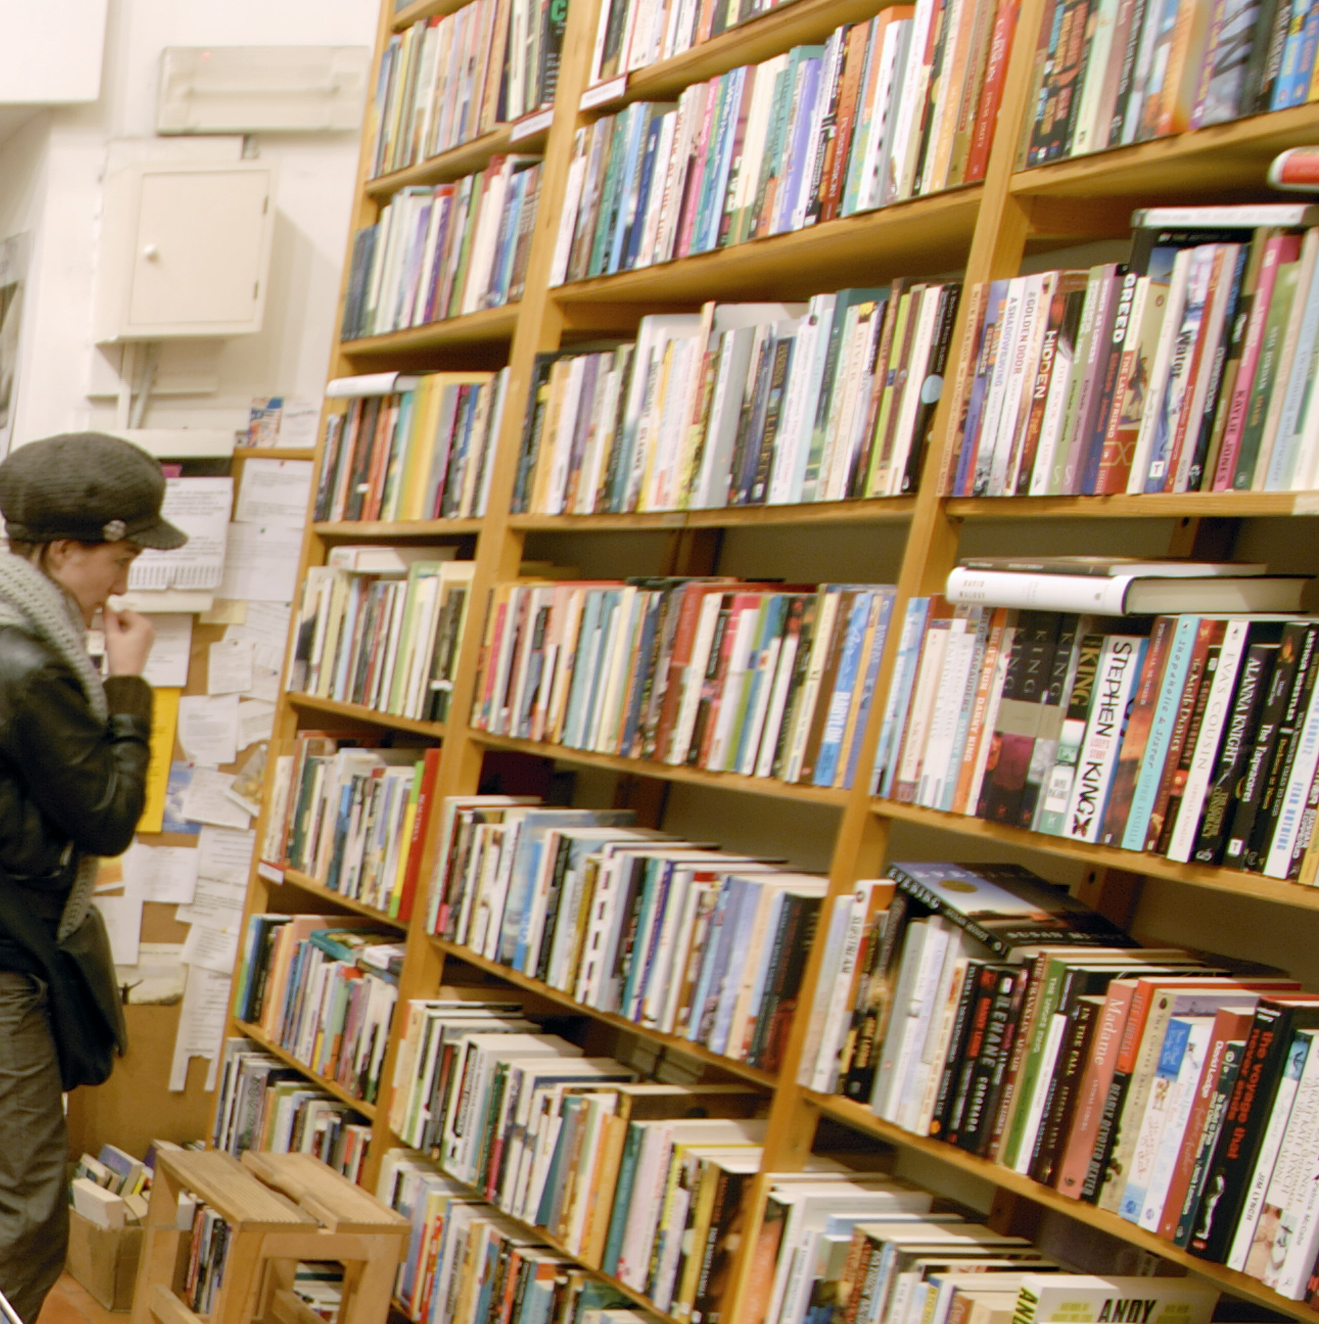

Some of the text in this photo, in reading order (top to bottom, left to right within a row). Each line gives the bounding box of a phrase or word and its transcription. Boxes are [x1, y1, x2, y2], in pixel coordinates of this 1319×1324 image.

[1113, 273, 1137, 343] GREED
[1033, 330, 1057, 399] HIDDEN
[1075, 641, 1132, 817] STEPHEN KING
[980, 996, 1011, 1067] LEHANE
[1094, 998, 1125, 1066] Madame
[1098, 1299, 1157, 1323] ANDY
